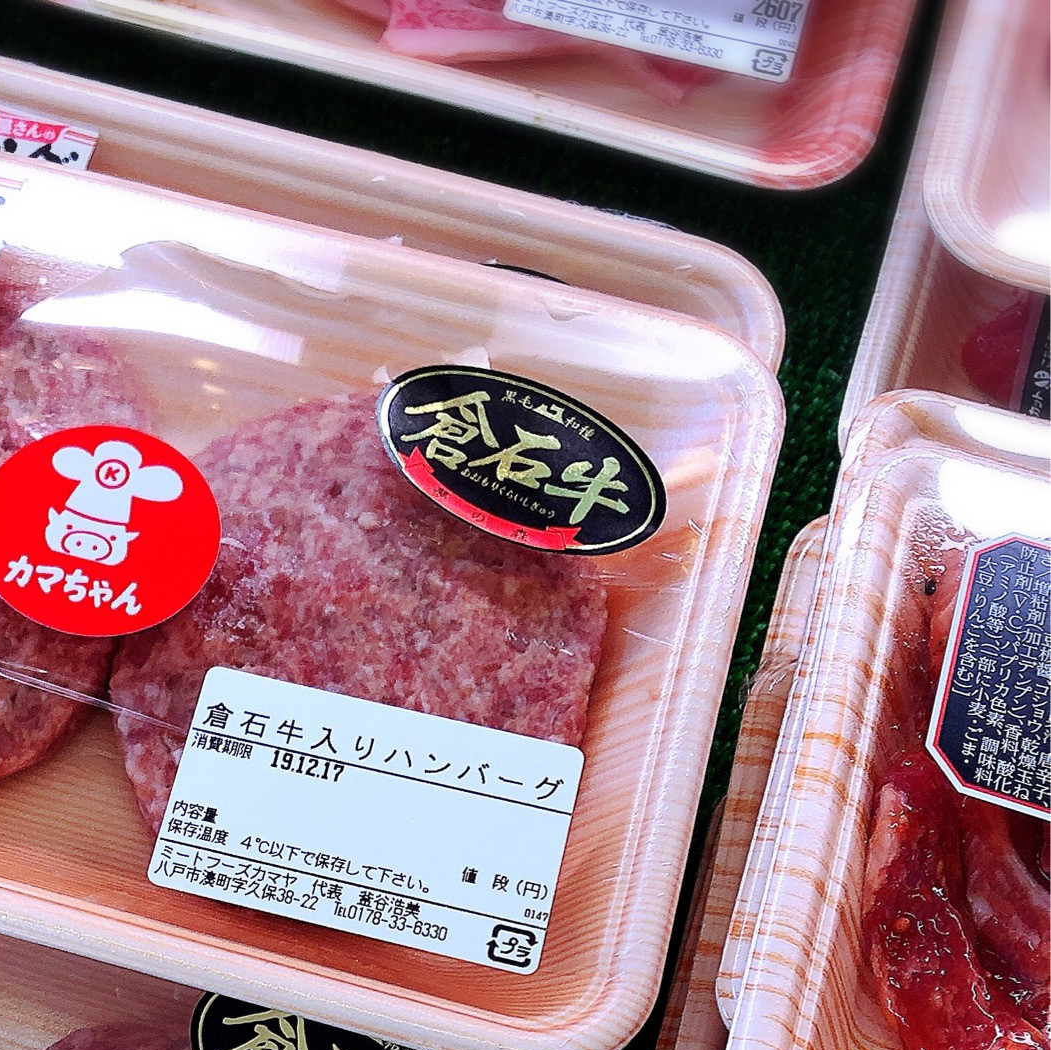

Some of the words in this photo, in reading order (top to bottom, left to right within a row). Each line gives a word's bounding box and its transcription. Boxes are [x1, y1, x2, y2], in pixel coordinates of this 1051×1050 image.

[103, 466, 121, 482] K
[400, 390, 631, 525] 倉石牛
[3, 555, 143, 617] カマちゃん
[191, 732, 253, 761] 消費期限
[270, 749, 345, 784] 19.12.17
[203, 701, 566, 802] 倉石牛入りハンバーグ
[166, 818, 230, 847] 保存温度
[170, 800, 219, 825] 内容量
[160, 845, 298, 887] ミートフーズカマヤ
[311, 879, 343, 902] 代表
[523, 907, 550, 923] 0147
